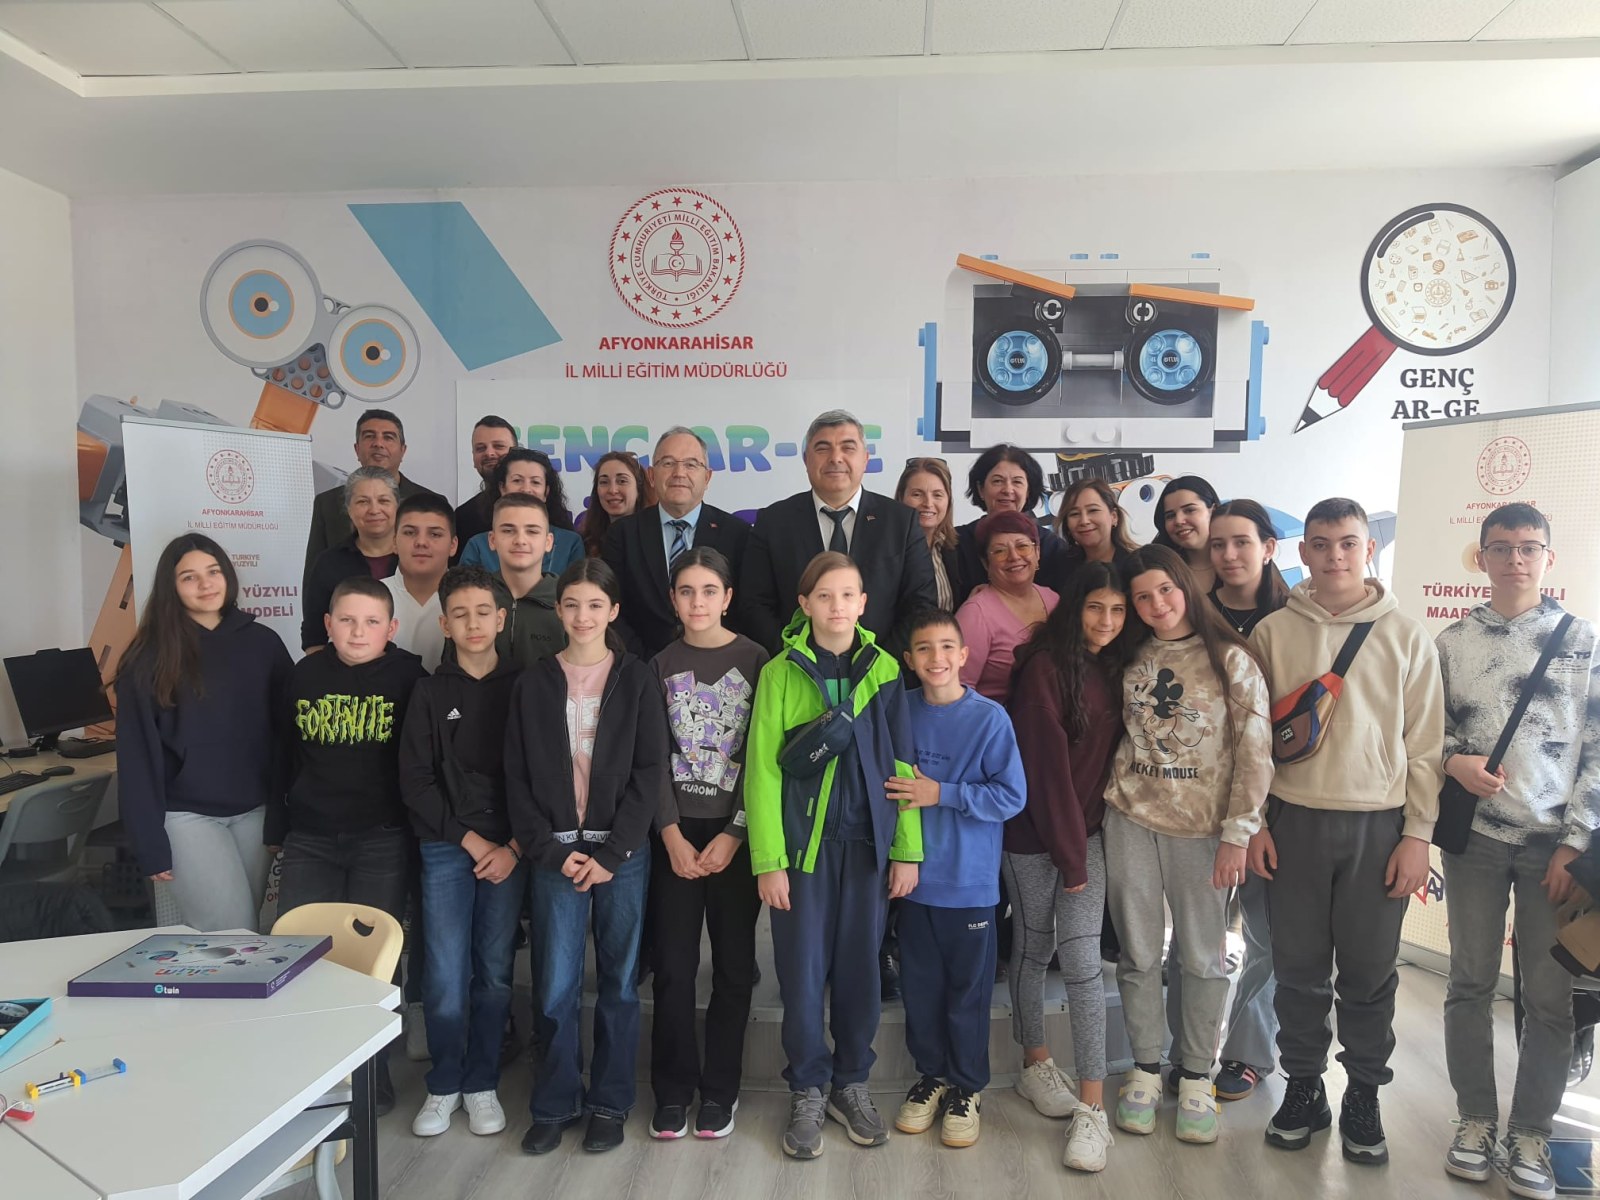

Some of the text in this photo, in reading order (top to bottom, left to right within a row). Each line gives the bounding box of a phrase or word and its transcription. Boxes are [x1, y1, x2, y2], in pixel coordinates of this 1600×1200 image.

[636, 213, 720, 301] TÜRKİYE CUMHURİYETİ MİLLİ EĞİTİM BAKANLIĞI
[599, 333, 753, 350] AFYONKARAHİSAR
[565, 362, 787, 378] İL MİLLİ EĞİTİM MÜDÜRLÜĞÜ
[1400, 368, 1474, 395] GENÇ
[1391, 400, 1479, 419] AR-GE
[201, 508, 264, 517] AFYONKARAHİSAR
[194, 521, 212, 529] MİLLİ
[213, 521, 237, 530] EĞİTİM
[242, 584, 298, 598] YÜZYILI
[1423, 582, 1491, 598] TÜRKİYE
[1427, 607, 1470, 619] MAAR
[295, 694, 394, 745] FORTNITE
[1163, 767, 1199, 779] MOUSE
[680, 782, 717, 796] KUROMI
[163, 986, 180, 995] twin
